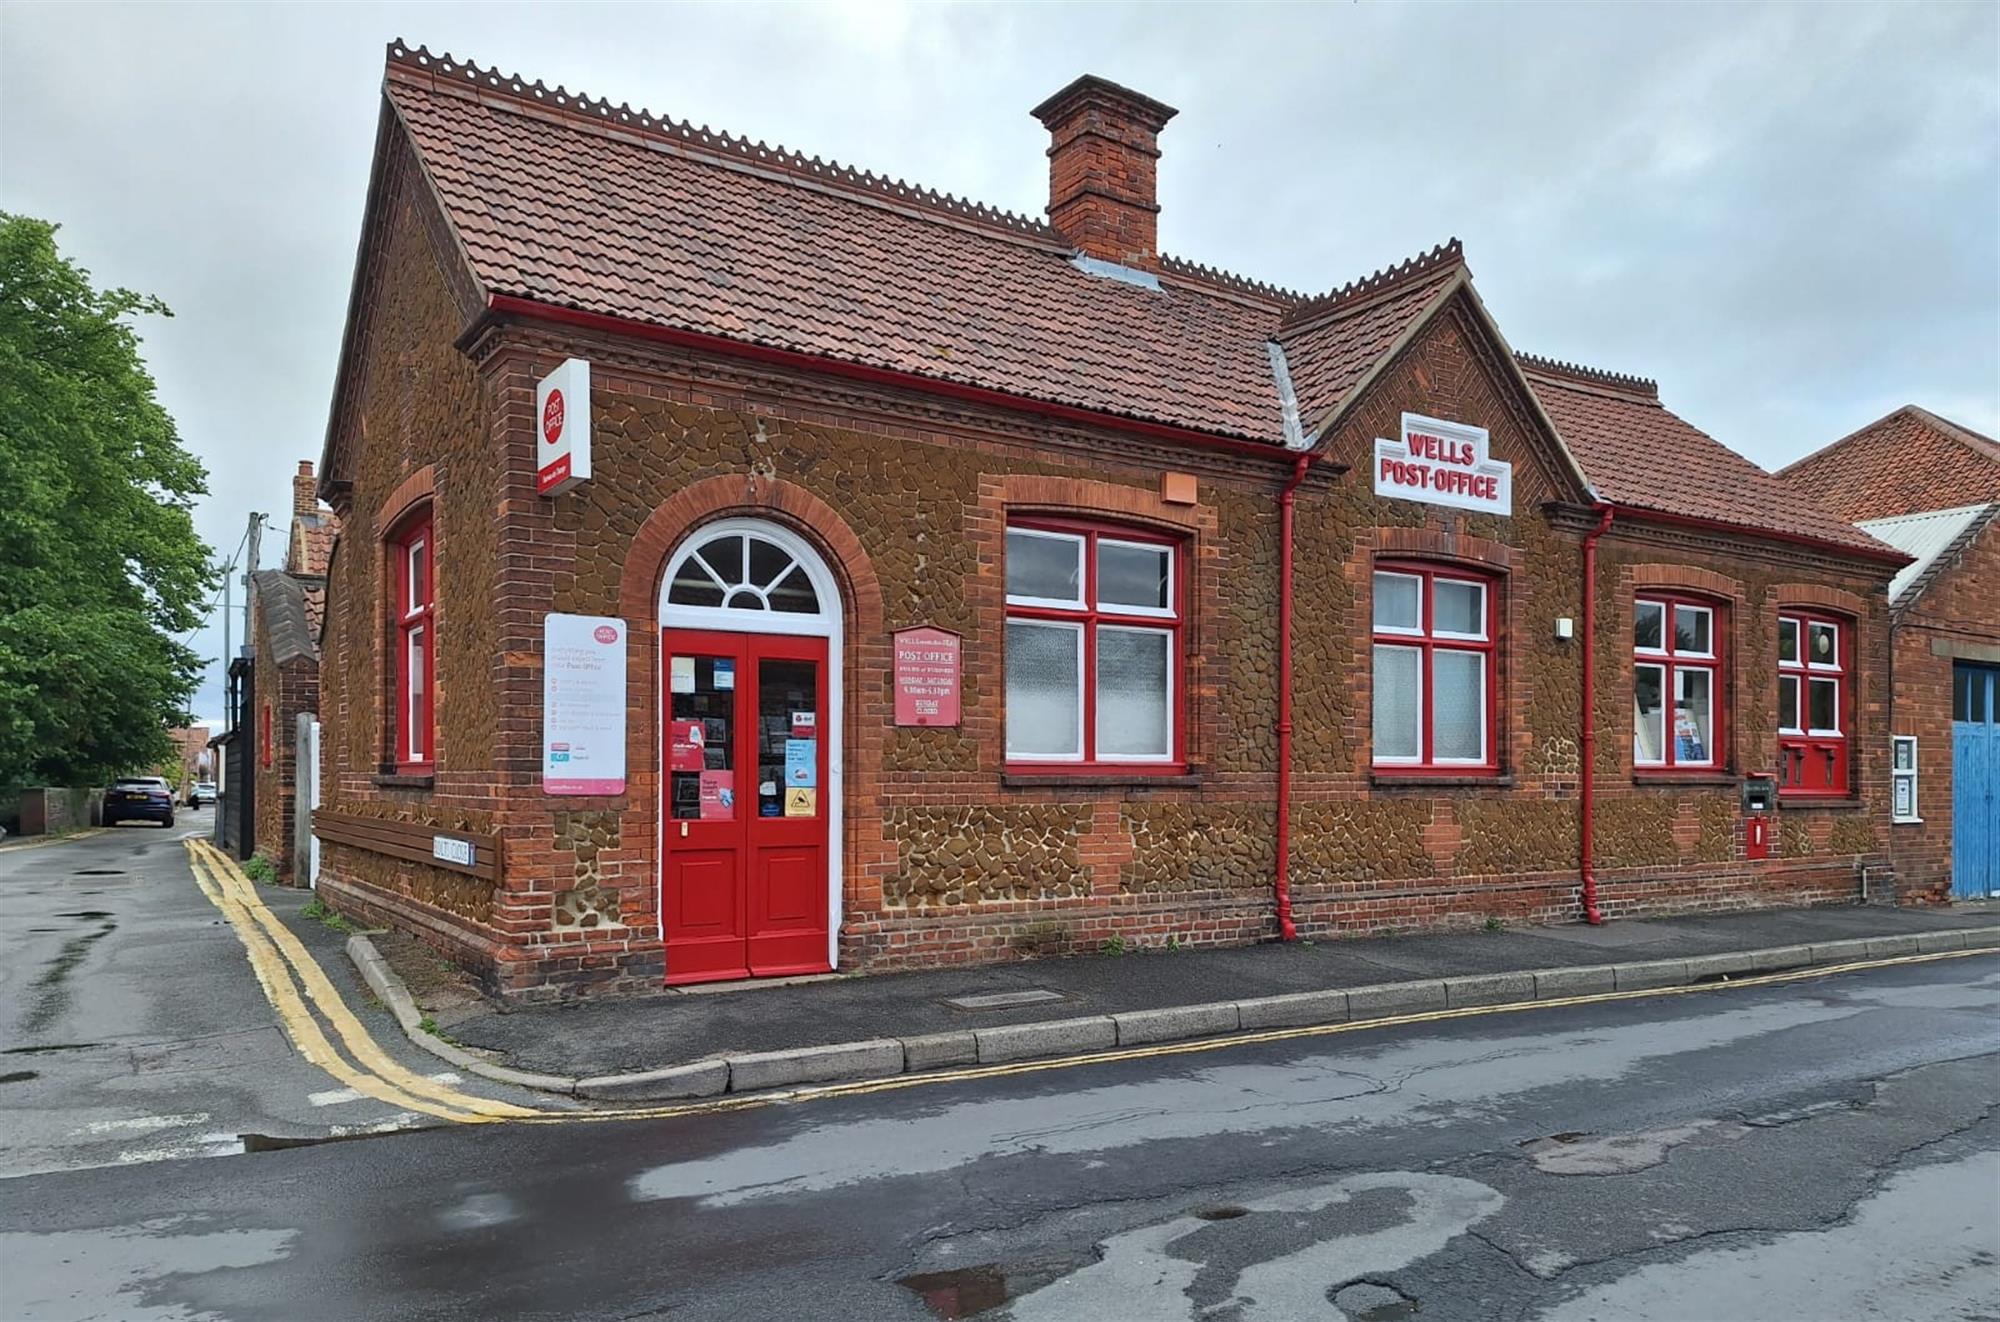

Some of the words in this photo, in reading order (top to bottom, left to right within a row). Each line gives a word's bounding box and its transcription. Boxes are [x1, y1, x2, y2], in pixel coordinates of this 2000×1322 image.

[546, 397, 561, 416] POST
[545, 411, 563, 434] OFFICE
[1407, 432, 1475, 466] WELLS
[899, 650, 921, 661] POST
[923, 651, 954, 662] OFFICE
